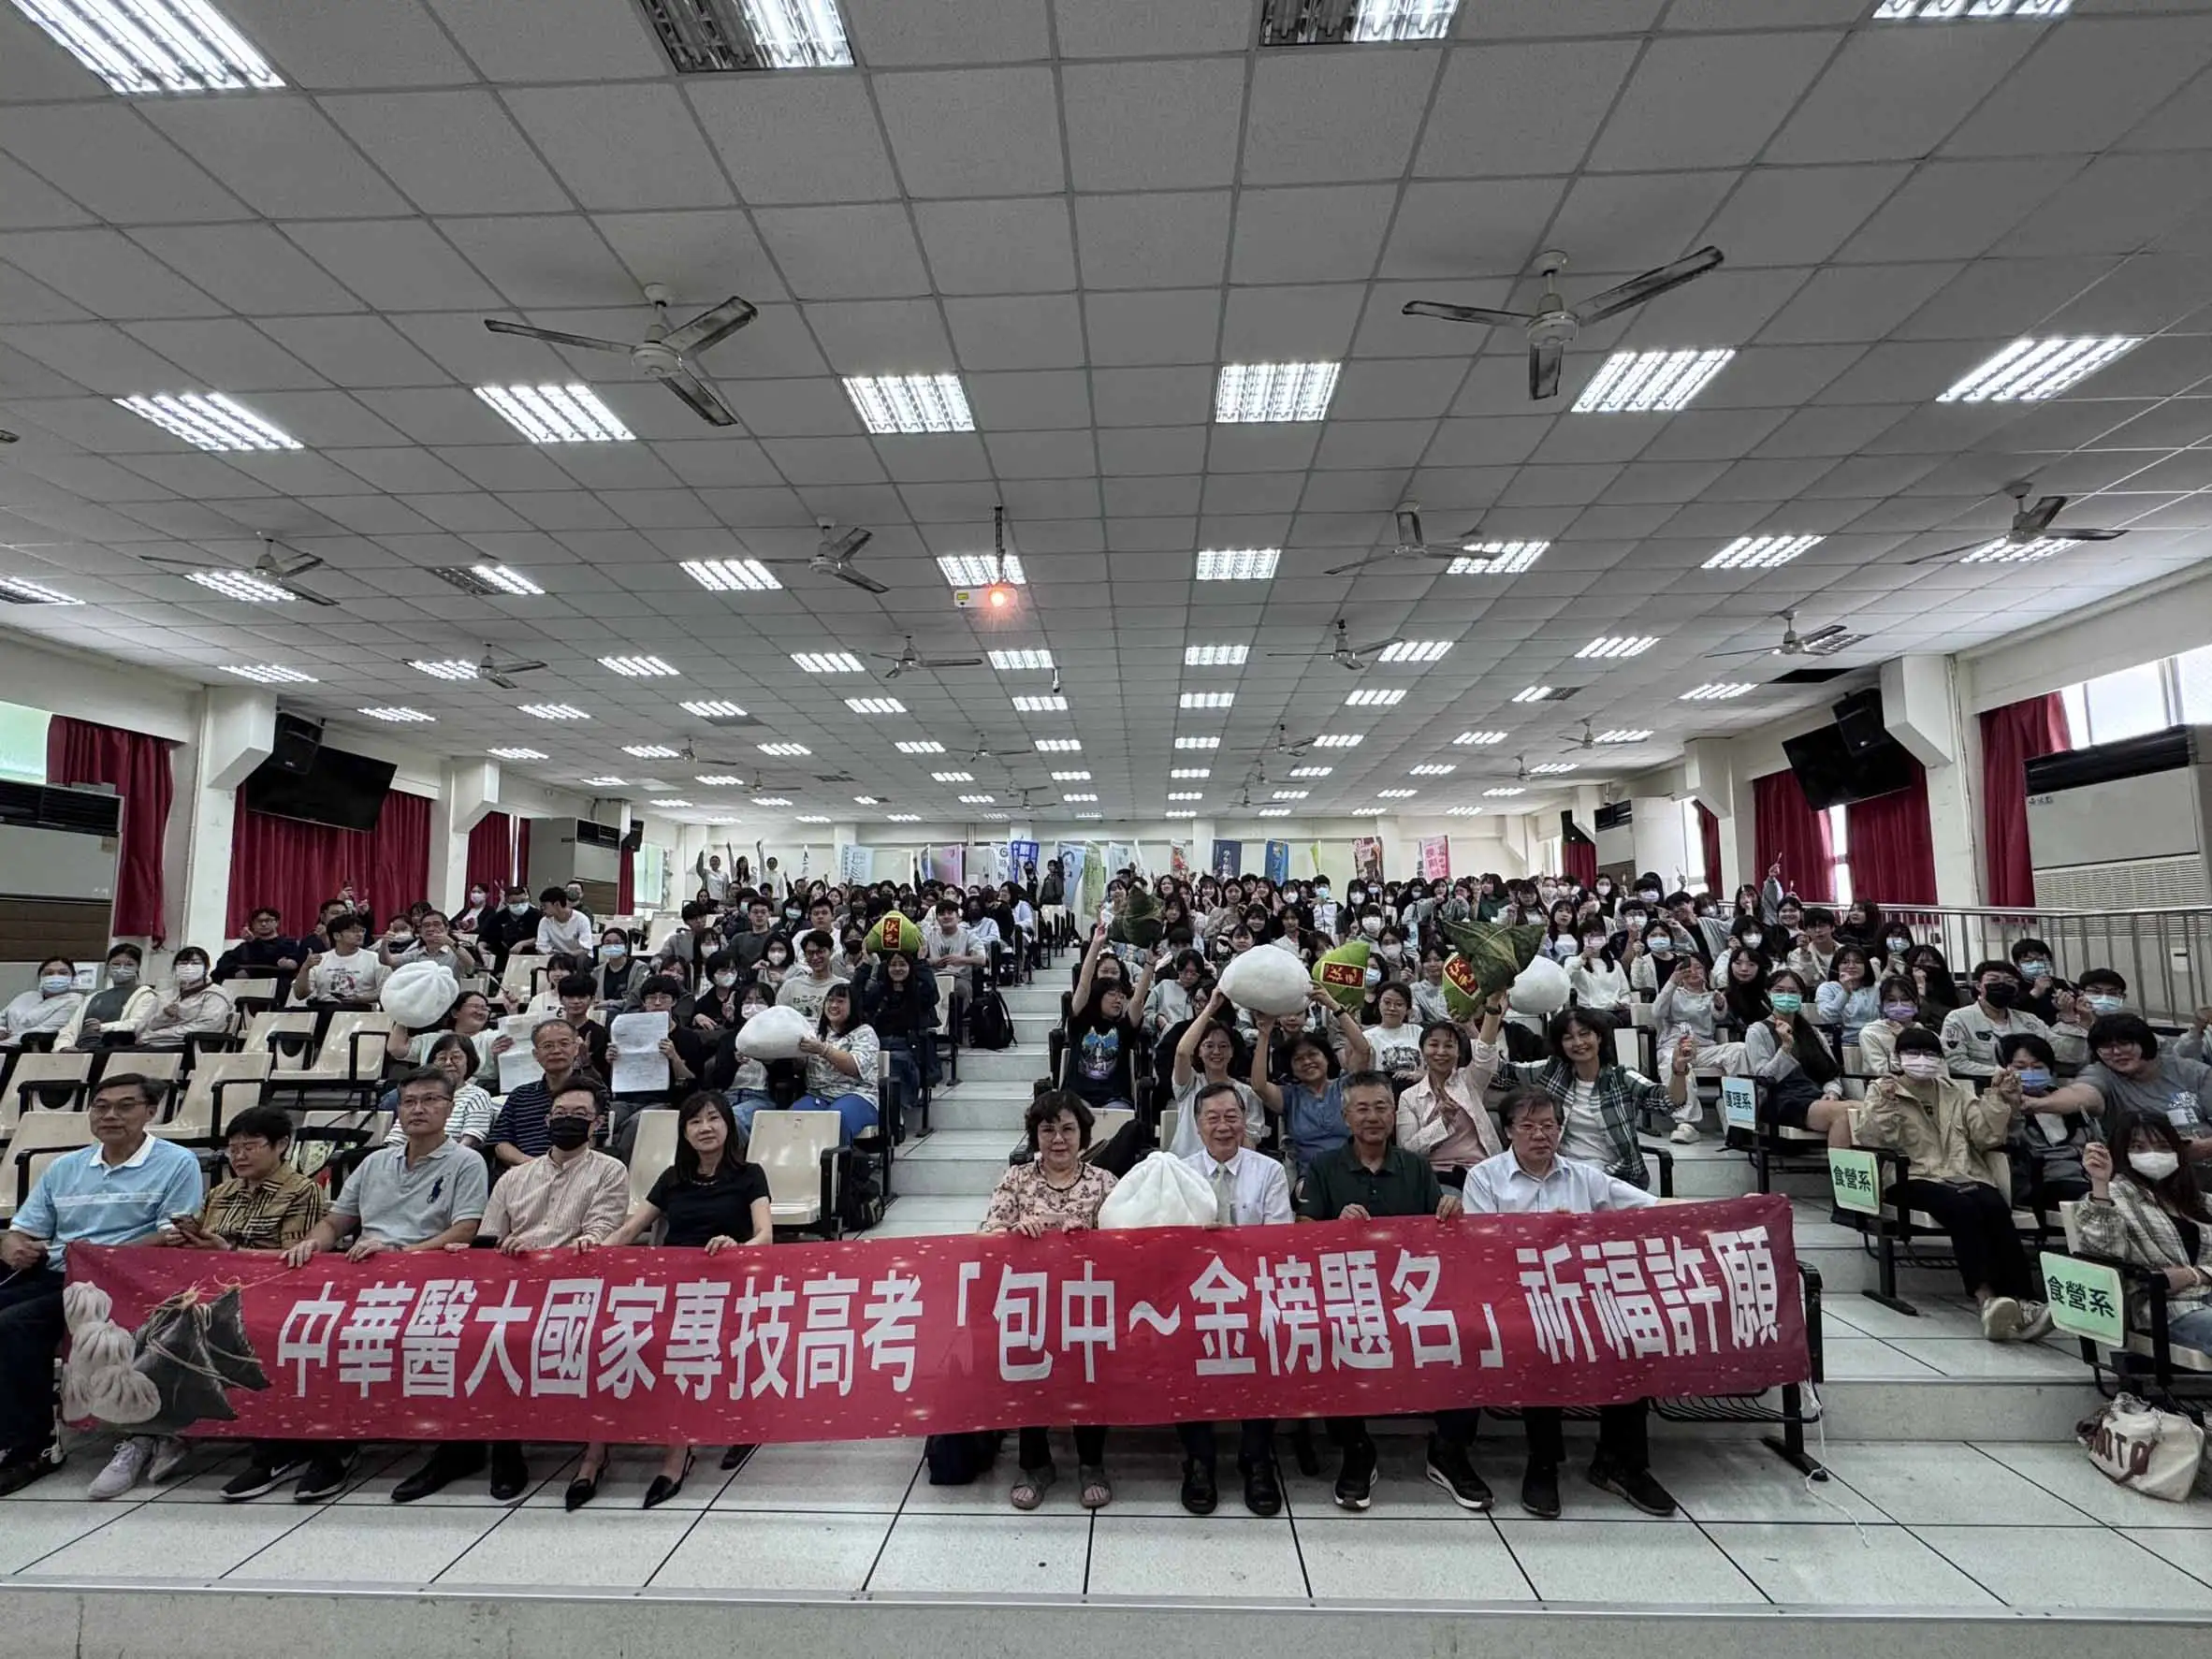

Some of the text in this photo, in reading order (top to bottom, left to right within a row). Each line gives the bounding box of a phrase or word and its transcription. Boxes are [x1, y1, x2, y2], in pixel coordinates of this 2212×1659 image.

[1833, 1165, 1871, 1193] 食營系
[2046, 1274, 2116, 1318] 食營系
